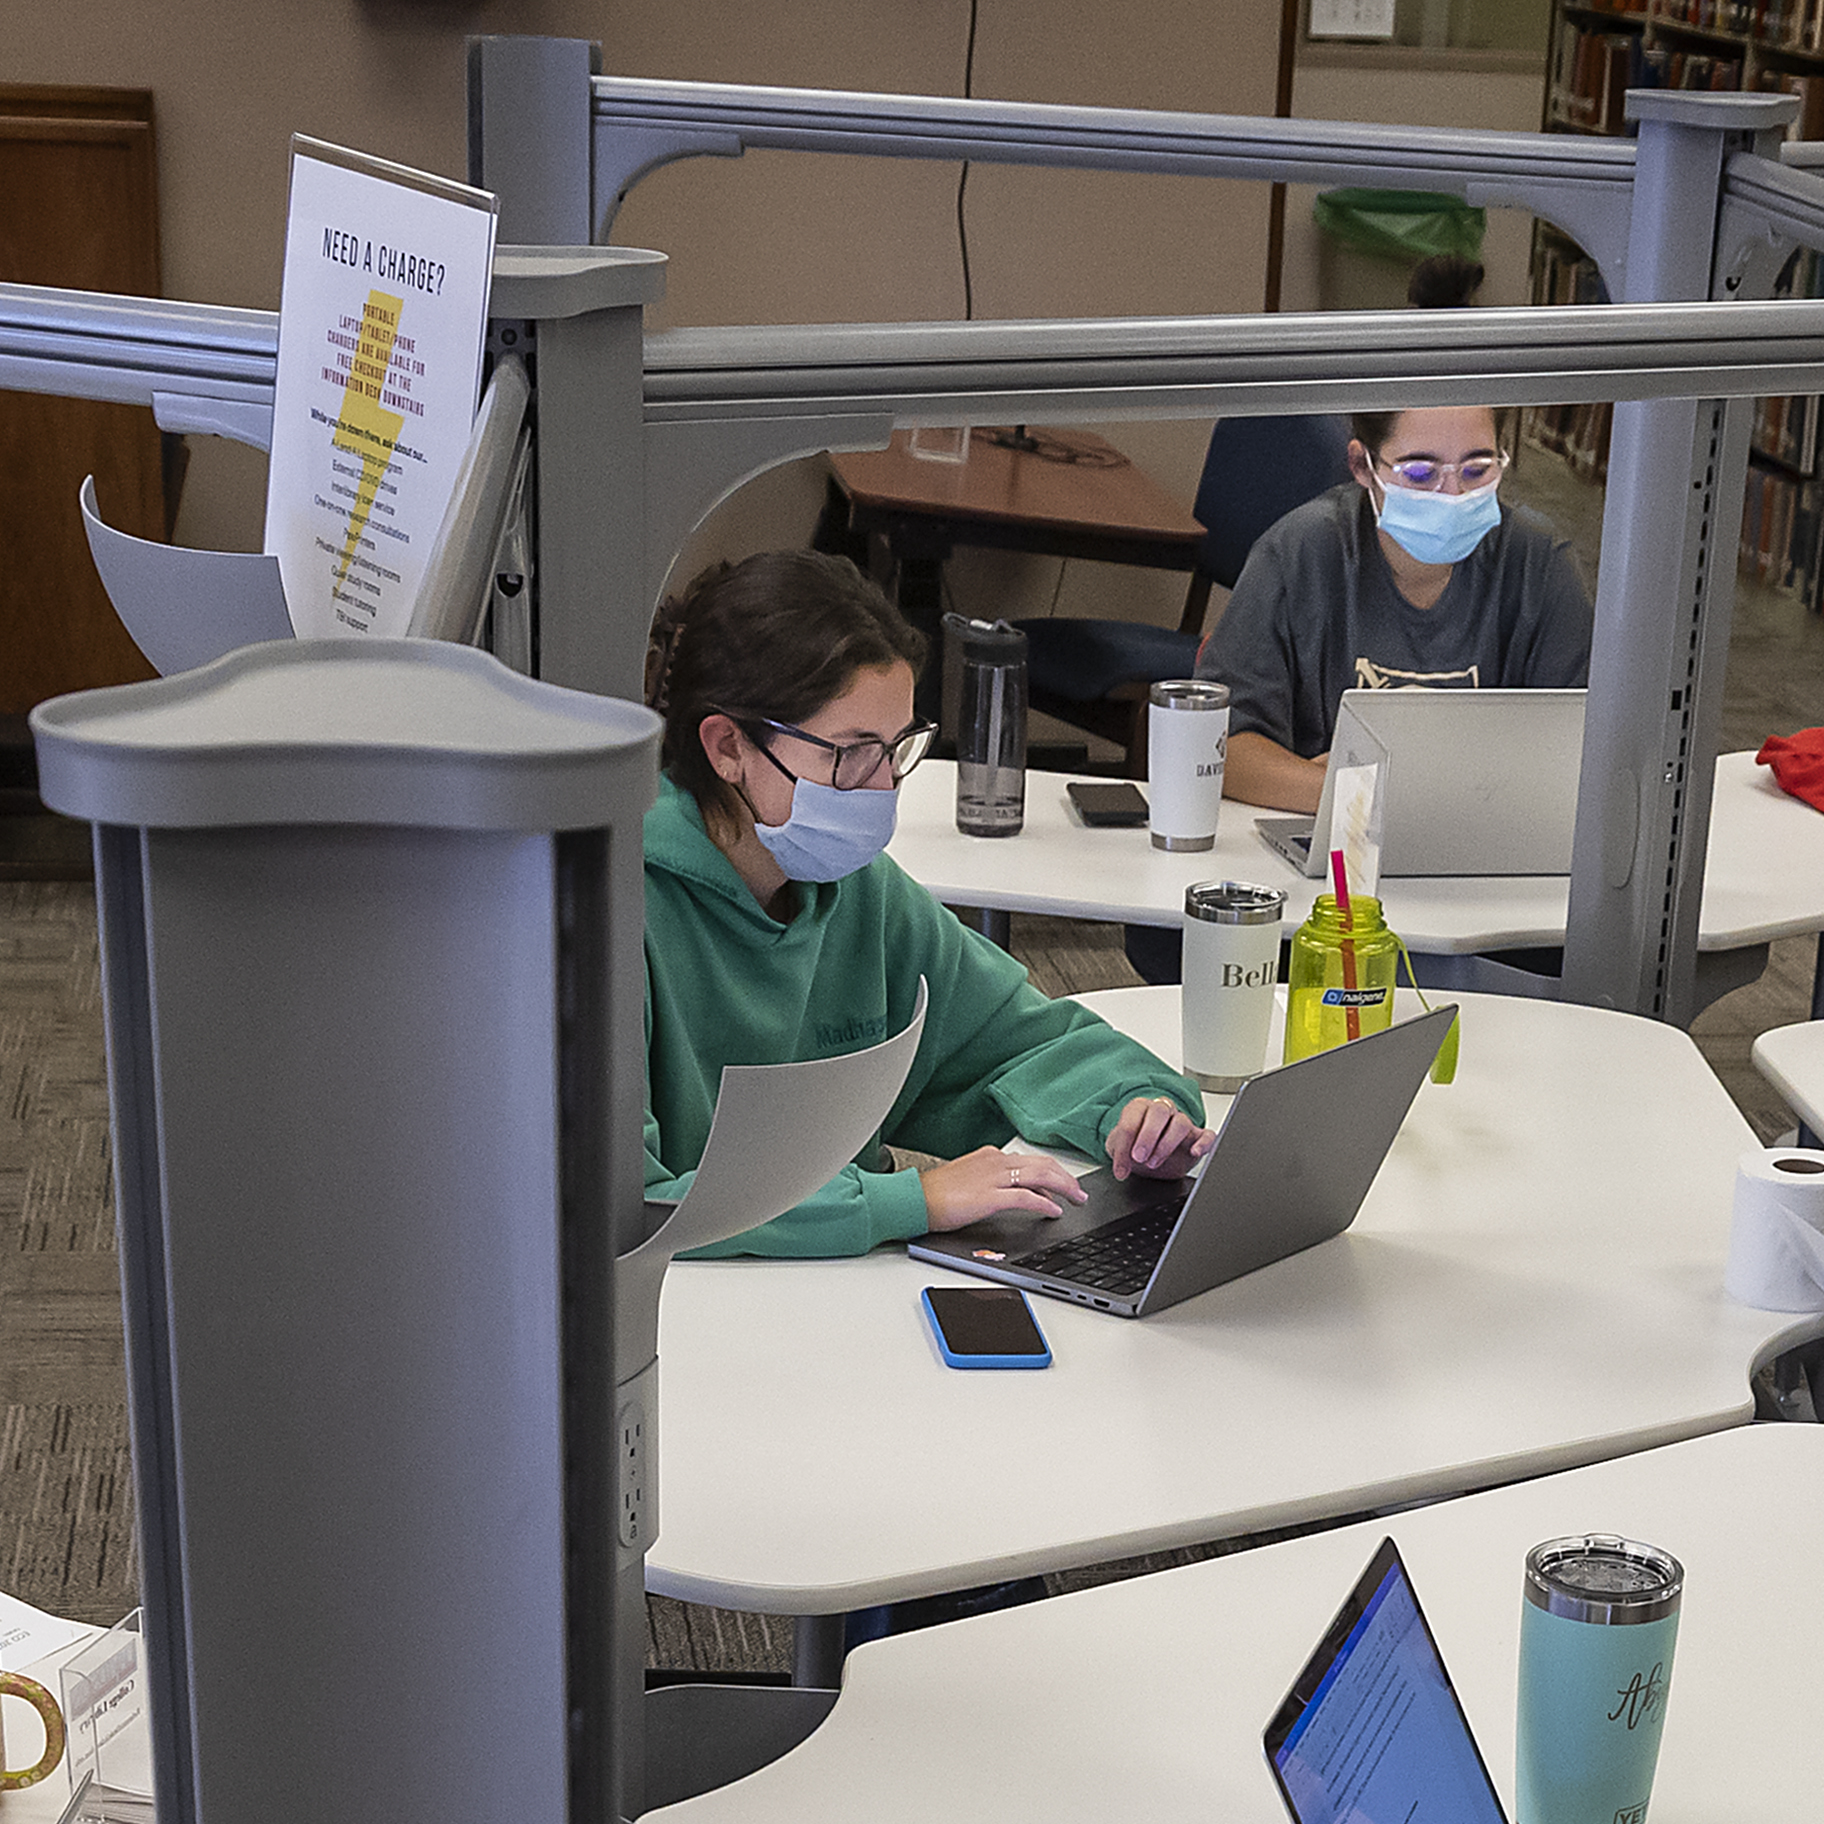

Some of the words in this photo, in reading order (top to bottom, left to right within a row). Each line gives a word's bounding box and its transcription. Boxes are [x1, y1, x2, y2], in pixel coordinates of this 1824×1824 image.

[323, 227, 358, 267] NEED
[363, 241, 372, 273] A
[378, 246, 445, 296] CHARGE?
[339, 314, 416, 354] LAPTOP/TABLET/PHONE
[363, 303, 395, 326] PORTABLE
[327, 329, 360, 353] CHARGERS
[361, 342, 373, 358] ARE
[375, 346, 411, 372] AVAILABLE
[412, 360, 425, 376] FOR
[337, 352, 352, 371] FREE
[354, 358, 387, 381] CHECKOUT
[388, 371, 398, 385] AT
[399, 374, 412, 392] THE
[321, 366, 363, 395] INFORMATION
[365, 382, 381, 400] DESK
[383, 389, 424, 417] DOWNSTAIRS
[1220, 960, 1275, 988] Bell
